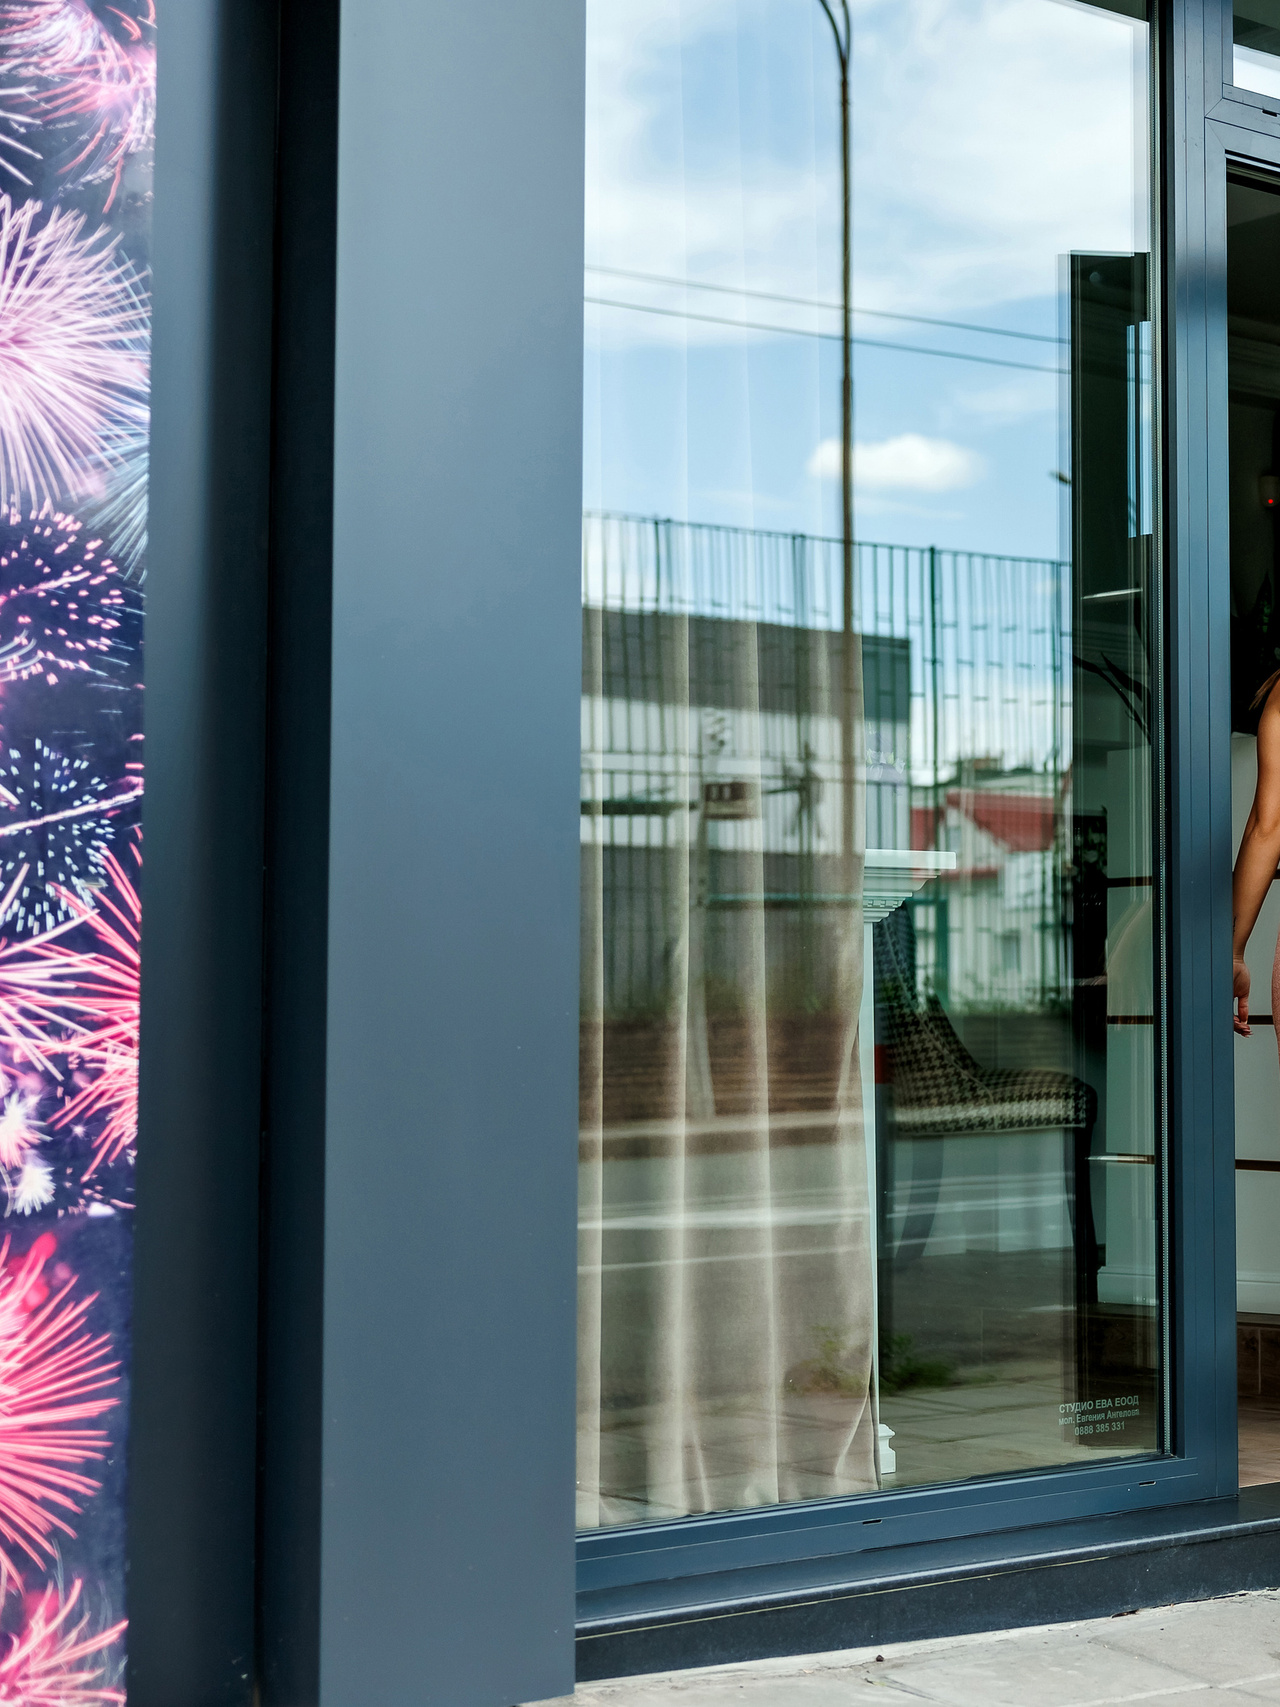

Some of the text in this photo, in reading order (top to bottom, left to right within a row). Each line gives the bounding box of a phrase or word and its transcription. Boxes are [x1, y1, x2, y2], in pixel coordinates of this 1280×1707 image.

[1059, 1395, 1139, 1414] СТУДИО ЕВА ЕООД
[1076, 1412, 1105, 1423] Евгения
[1106, 1409, 1140, 1420] Ангелова
[1074, 1421, 1125, 1436] 0888 385 331
